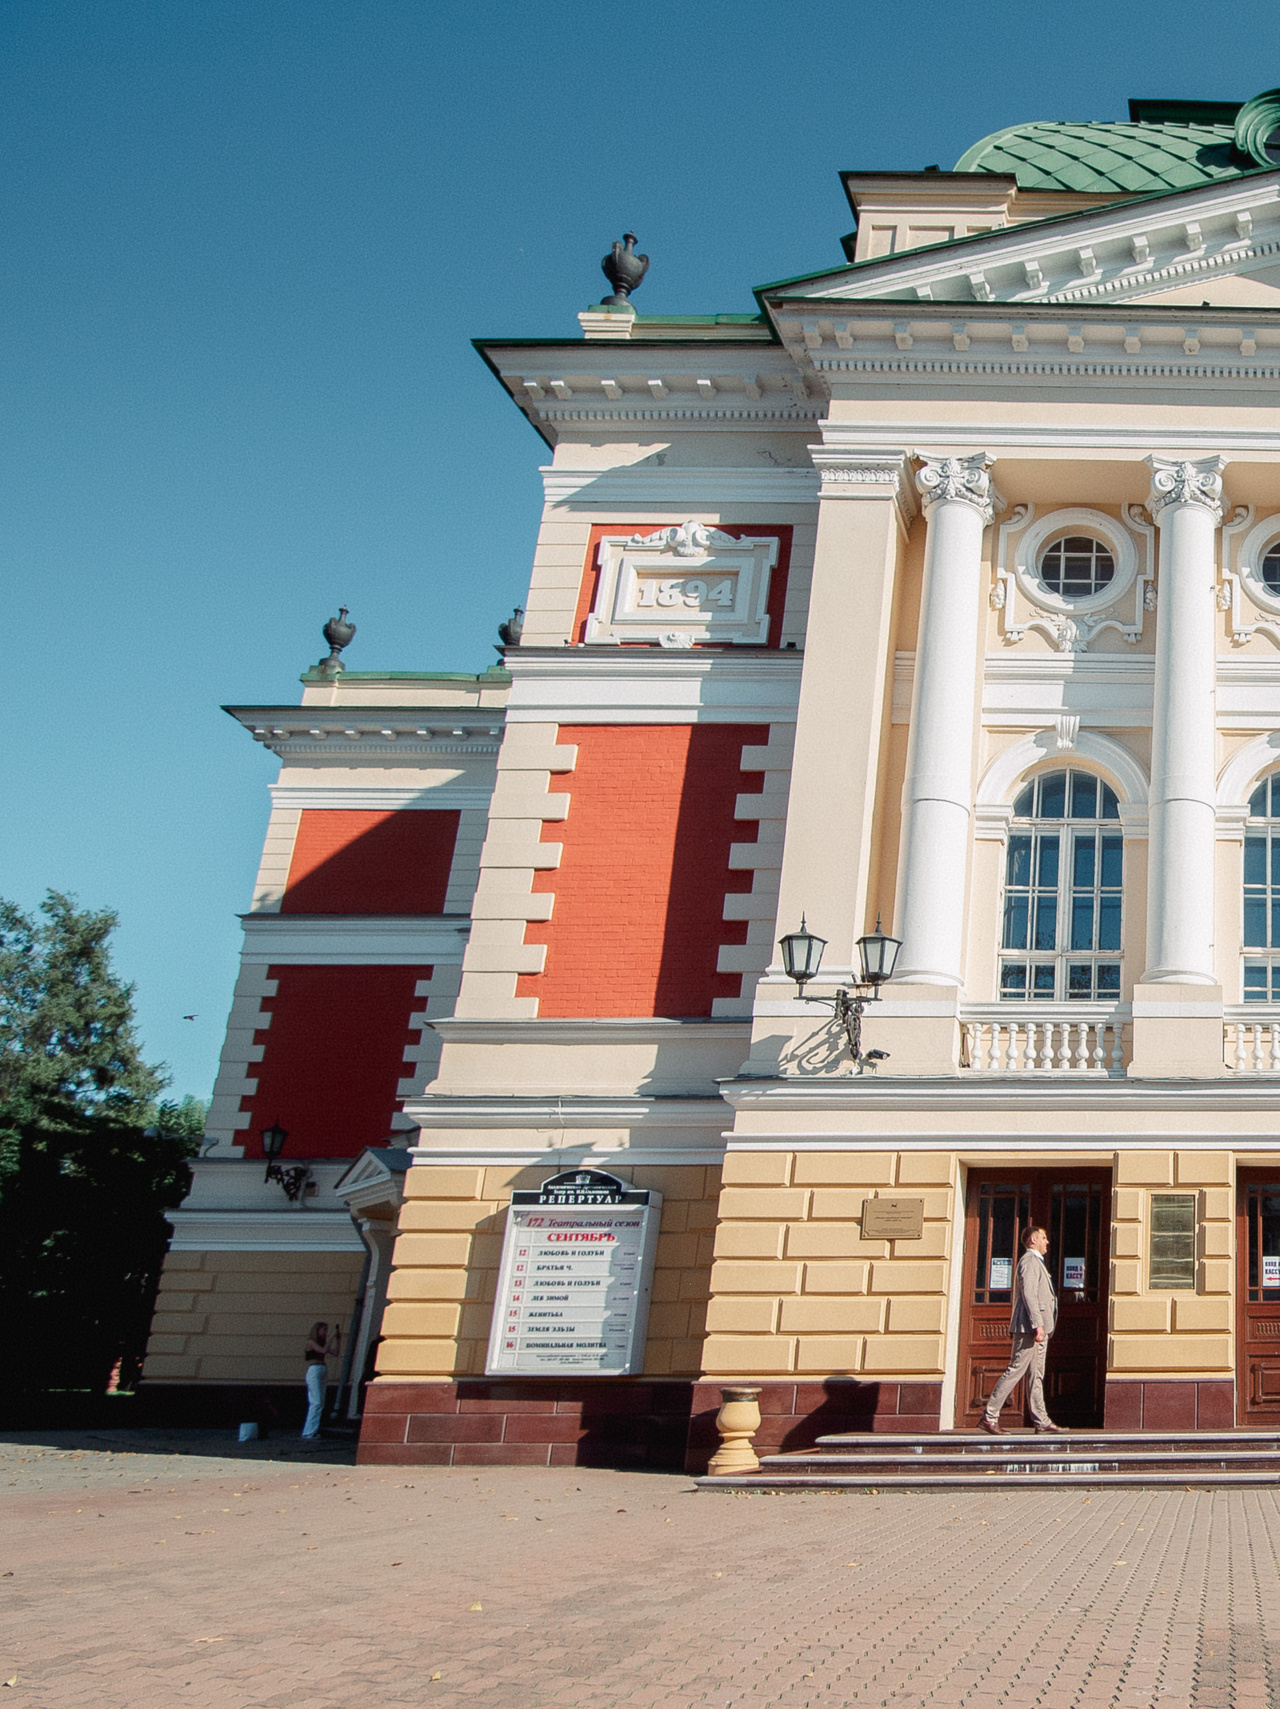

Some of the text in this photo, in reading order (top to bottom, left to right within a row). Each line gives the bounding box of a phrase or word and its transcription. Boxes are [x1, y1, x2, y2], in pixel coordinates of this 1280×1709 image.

[638, 579, 733, 607] 1894
[539, 1195, 622, 1204] РЕПЕРТУАР
[527, 1218, 544, 1227] 172
[548, 1219, 612, 1228] Театральный
[547, 1232, 616, 1242] СЕНТЯБРЬ
